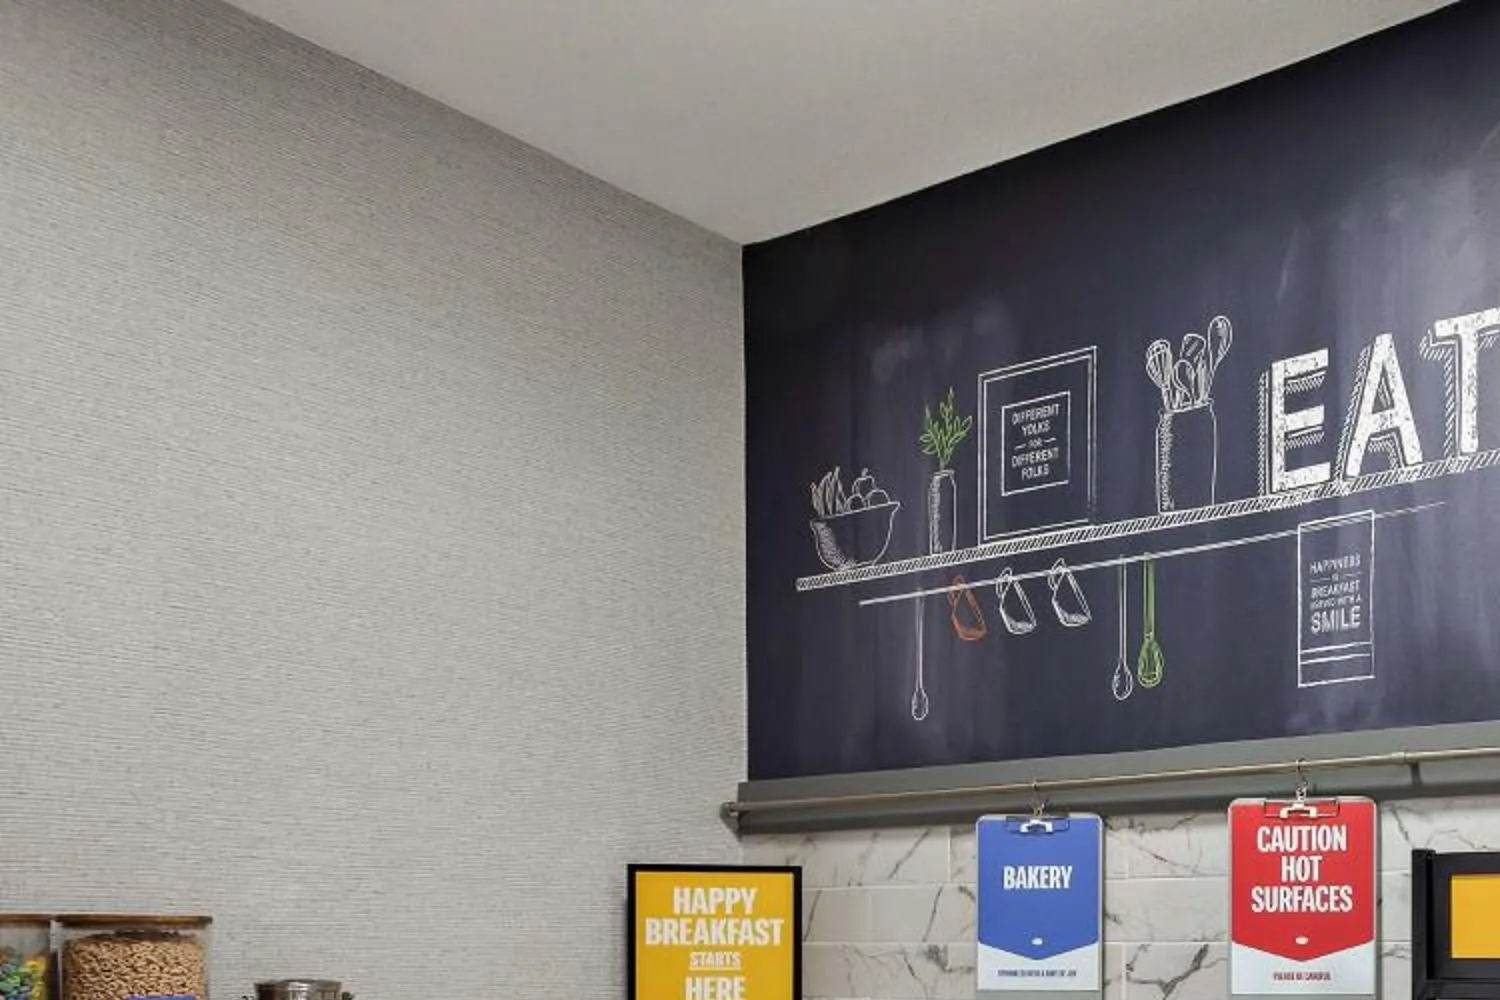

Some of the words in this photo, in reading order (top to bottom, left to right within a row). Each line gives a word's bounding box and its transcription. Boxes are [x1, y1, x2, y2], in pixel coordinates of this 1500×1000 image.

[1011, 403, 1060, 425] DIFFERENT
[1021, 420, 1051, 437] YOLKS
[1011, 447, 1060, 468] DIFFERENT
[1311, 605, 1361, 634] SMILE
[1256, 825, 1347, 853] CAUTION
[1003, 865, 1073, 890] BAKERY
[1281, 855, 1323, 882] HOT
[673, 886, 759, 915] HAPPY
[1251, 885, 1354, 913] SURFACES
[644, 917, 785, 946] BREAKFAST
[689, 952, 742, 968] STARTS
